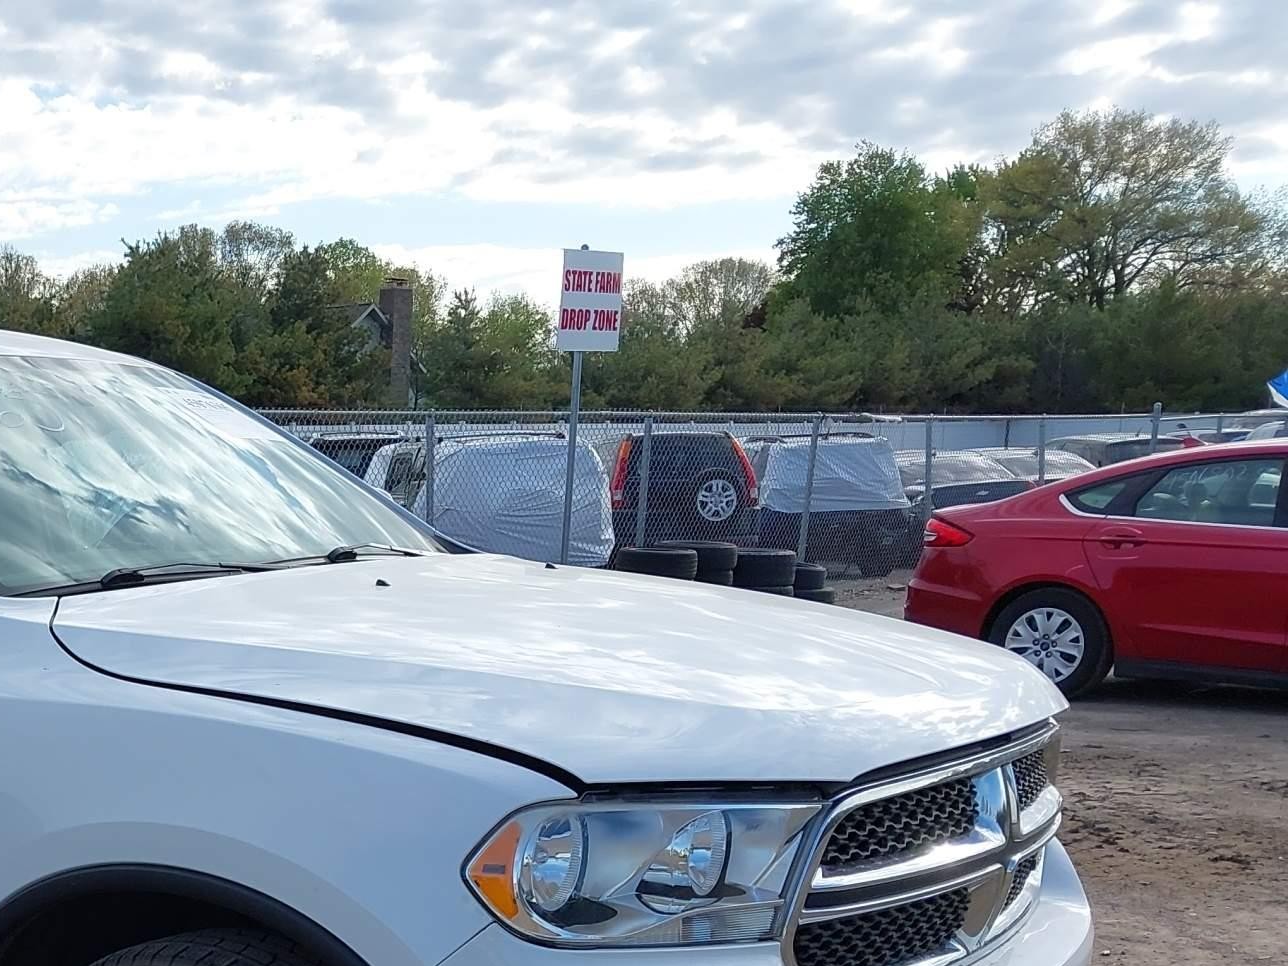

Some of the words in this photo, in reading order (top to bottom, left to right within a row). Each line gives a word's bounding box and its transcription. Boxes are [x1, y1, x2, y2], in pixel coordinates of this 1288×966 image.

[564, 269, 593, 292] STATE
[595, 271, 621, 294] FARM
[560, 308, 591, 330] DROP
[592, 309, 618, 331] ZONE
